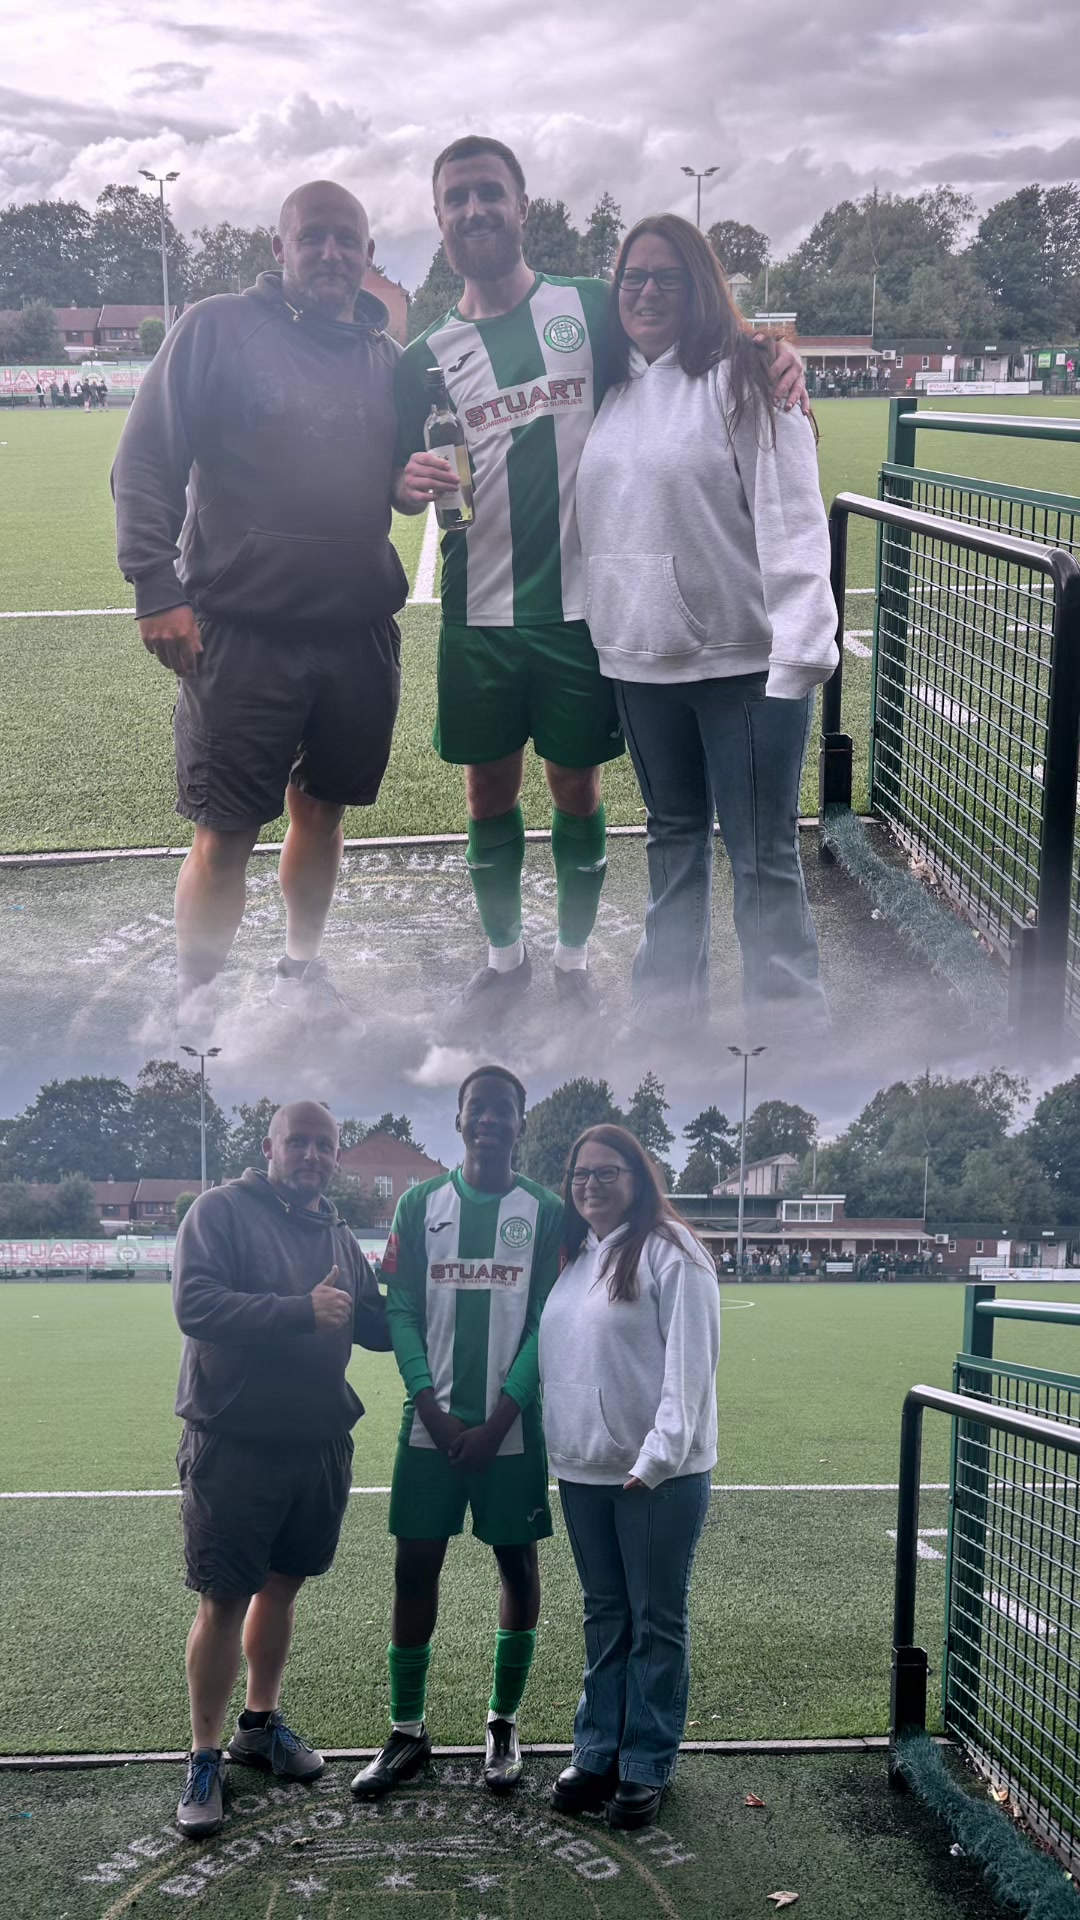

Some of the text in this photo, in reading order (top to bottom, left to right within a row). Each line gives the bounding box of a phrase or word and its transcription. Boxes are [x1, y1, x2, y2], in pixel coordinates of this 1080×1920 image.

[465, 377, 587, 428] STUART
[475, 416, 513, 433] PLUMBING
[550, 398, 583, 407] SUPPLIES
[430, 1263, 524, 1282] STUART
[489, 1279, 517, 1287] SUPPLIES
[463, 1803, 621, 1881] UNITED
